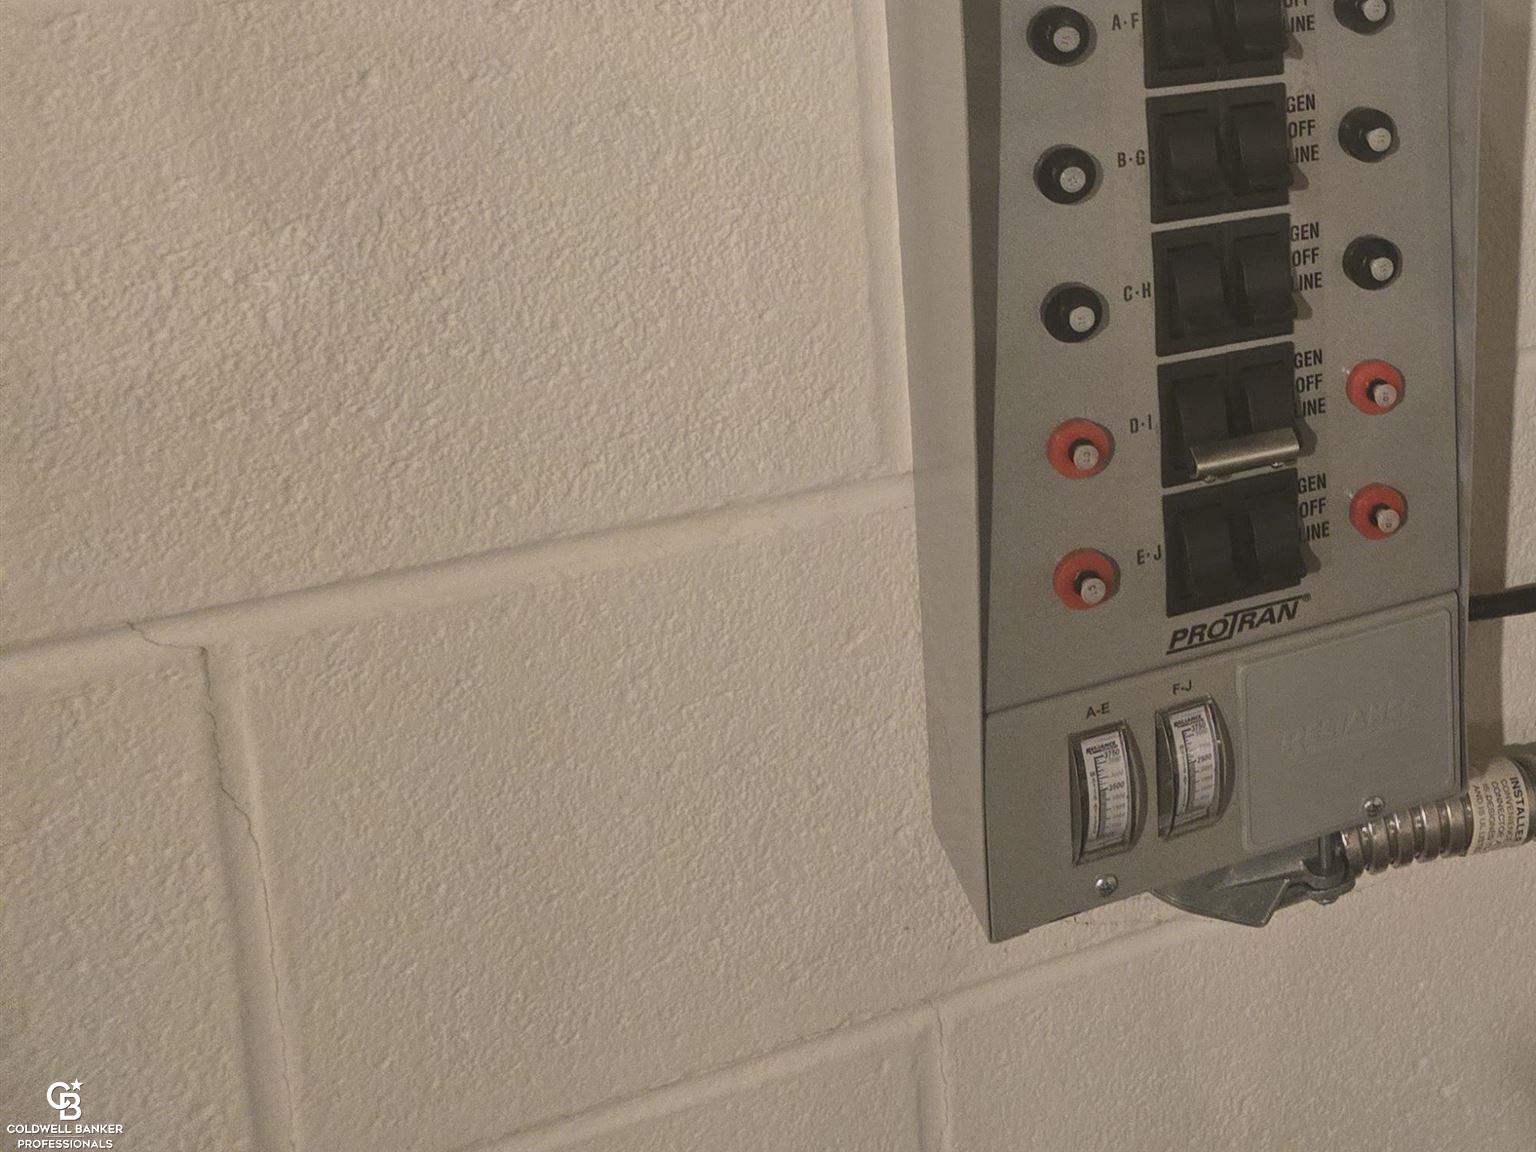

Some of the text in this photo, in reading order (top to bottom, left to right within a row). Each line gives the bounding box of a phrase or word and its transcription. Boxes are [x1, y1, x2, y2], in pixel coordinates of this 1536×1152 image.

[1287, 94, 1315, 113] GEN
[1289, 119, 1315, 138] OFF
[1291, 222, 1319, 241] GEN
[1292, 247, 1319, 266] OFF
[1295, 349, 1322, 368] GEN
[1296, 374, 1323, 393] OFF
[1298, 473, 1326, 494] GEN
[1301, 497, 1326, 518] OFF
[1172, 680, 1192, 695] F-J
[1086, 702, 1110, 719] A-E
